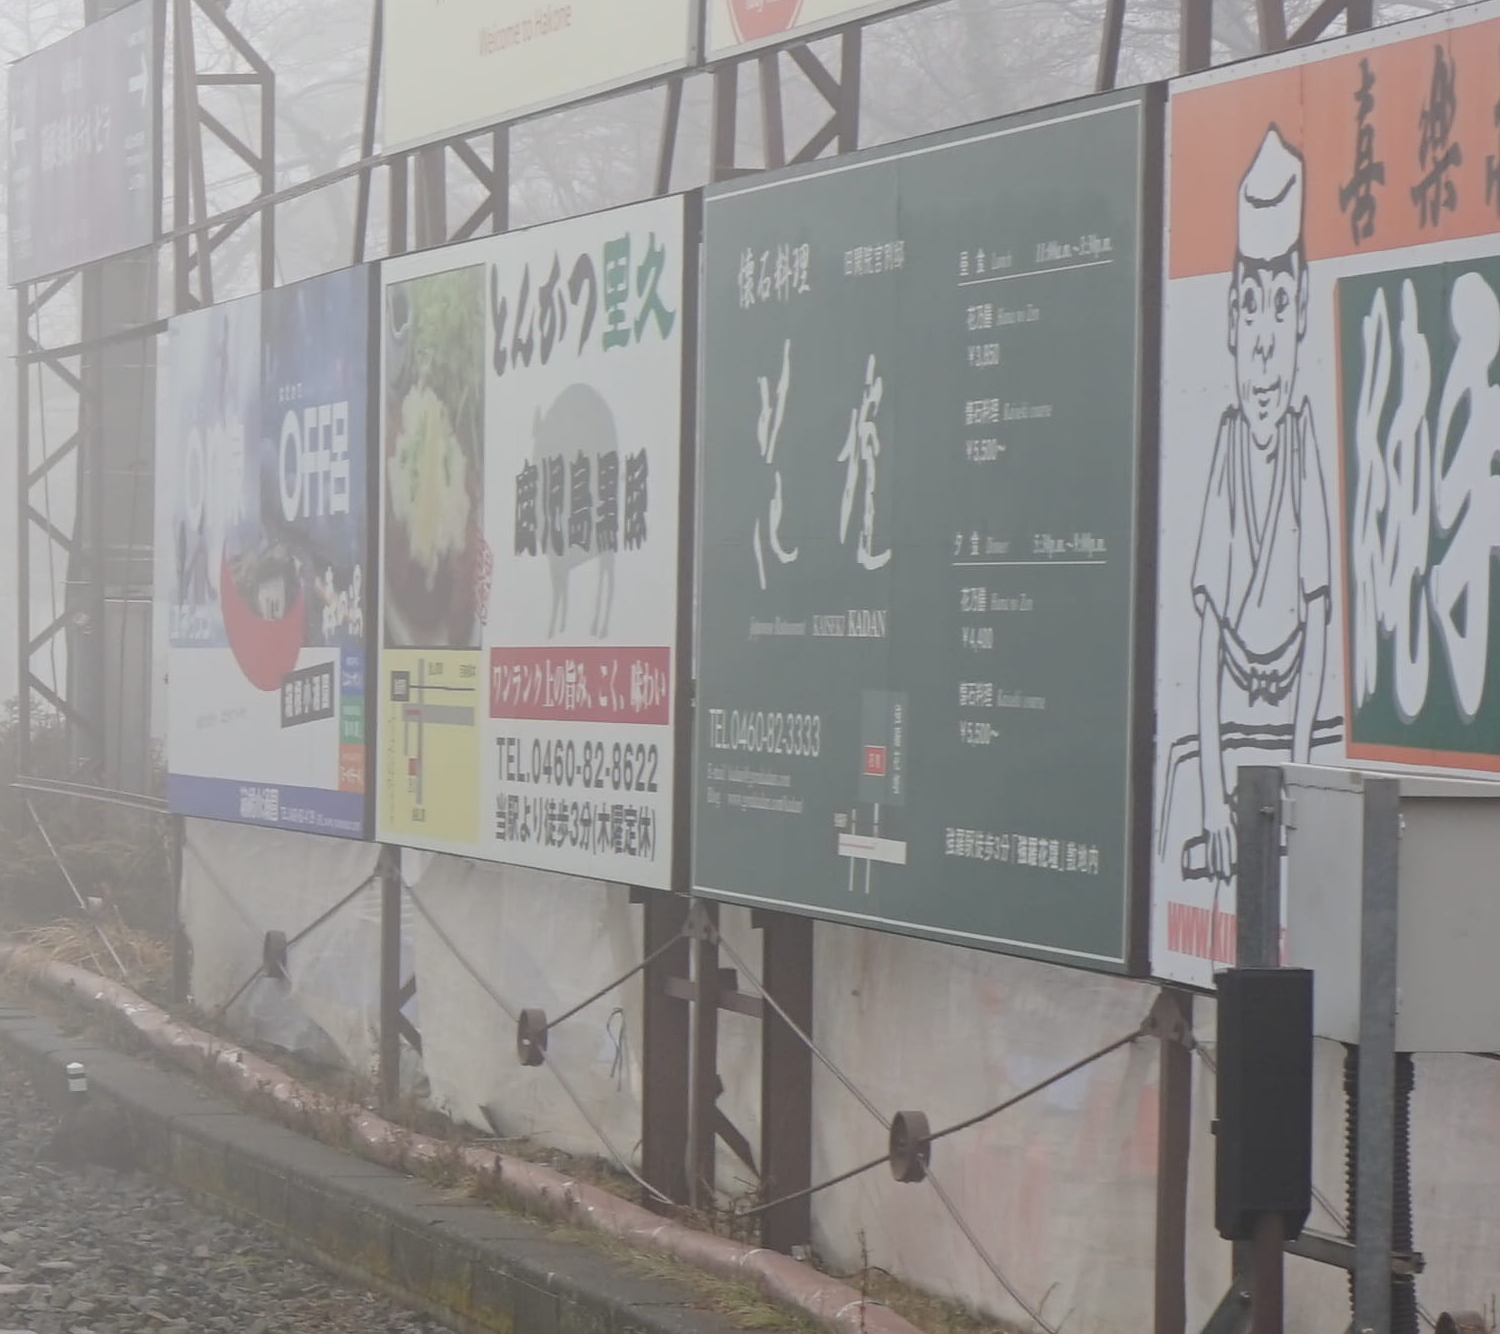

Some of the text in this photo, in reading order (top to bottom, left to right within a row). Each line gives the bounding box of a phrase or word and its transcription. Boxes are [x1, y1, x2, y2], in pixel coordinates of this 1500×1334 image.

[478, 18, 521, 56] Welcome
[534, 4, 573, 38] Hakone
[1339, 32, 1500, 248] 喜樂
[279, 399, 352, 523] OFF呂
[514, 446, 649, 558] 鹿児島黒豚
[846, 608, 889, 638] KADAN
[492, 658, 668, 714] ワンランク上の旨み、こく、味わい
[495, 736, 659, 794] TEL.0460-82-8622
[494, 792, 658, 862] 当駅より徒歩3分(木曜定休)
